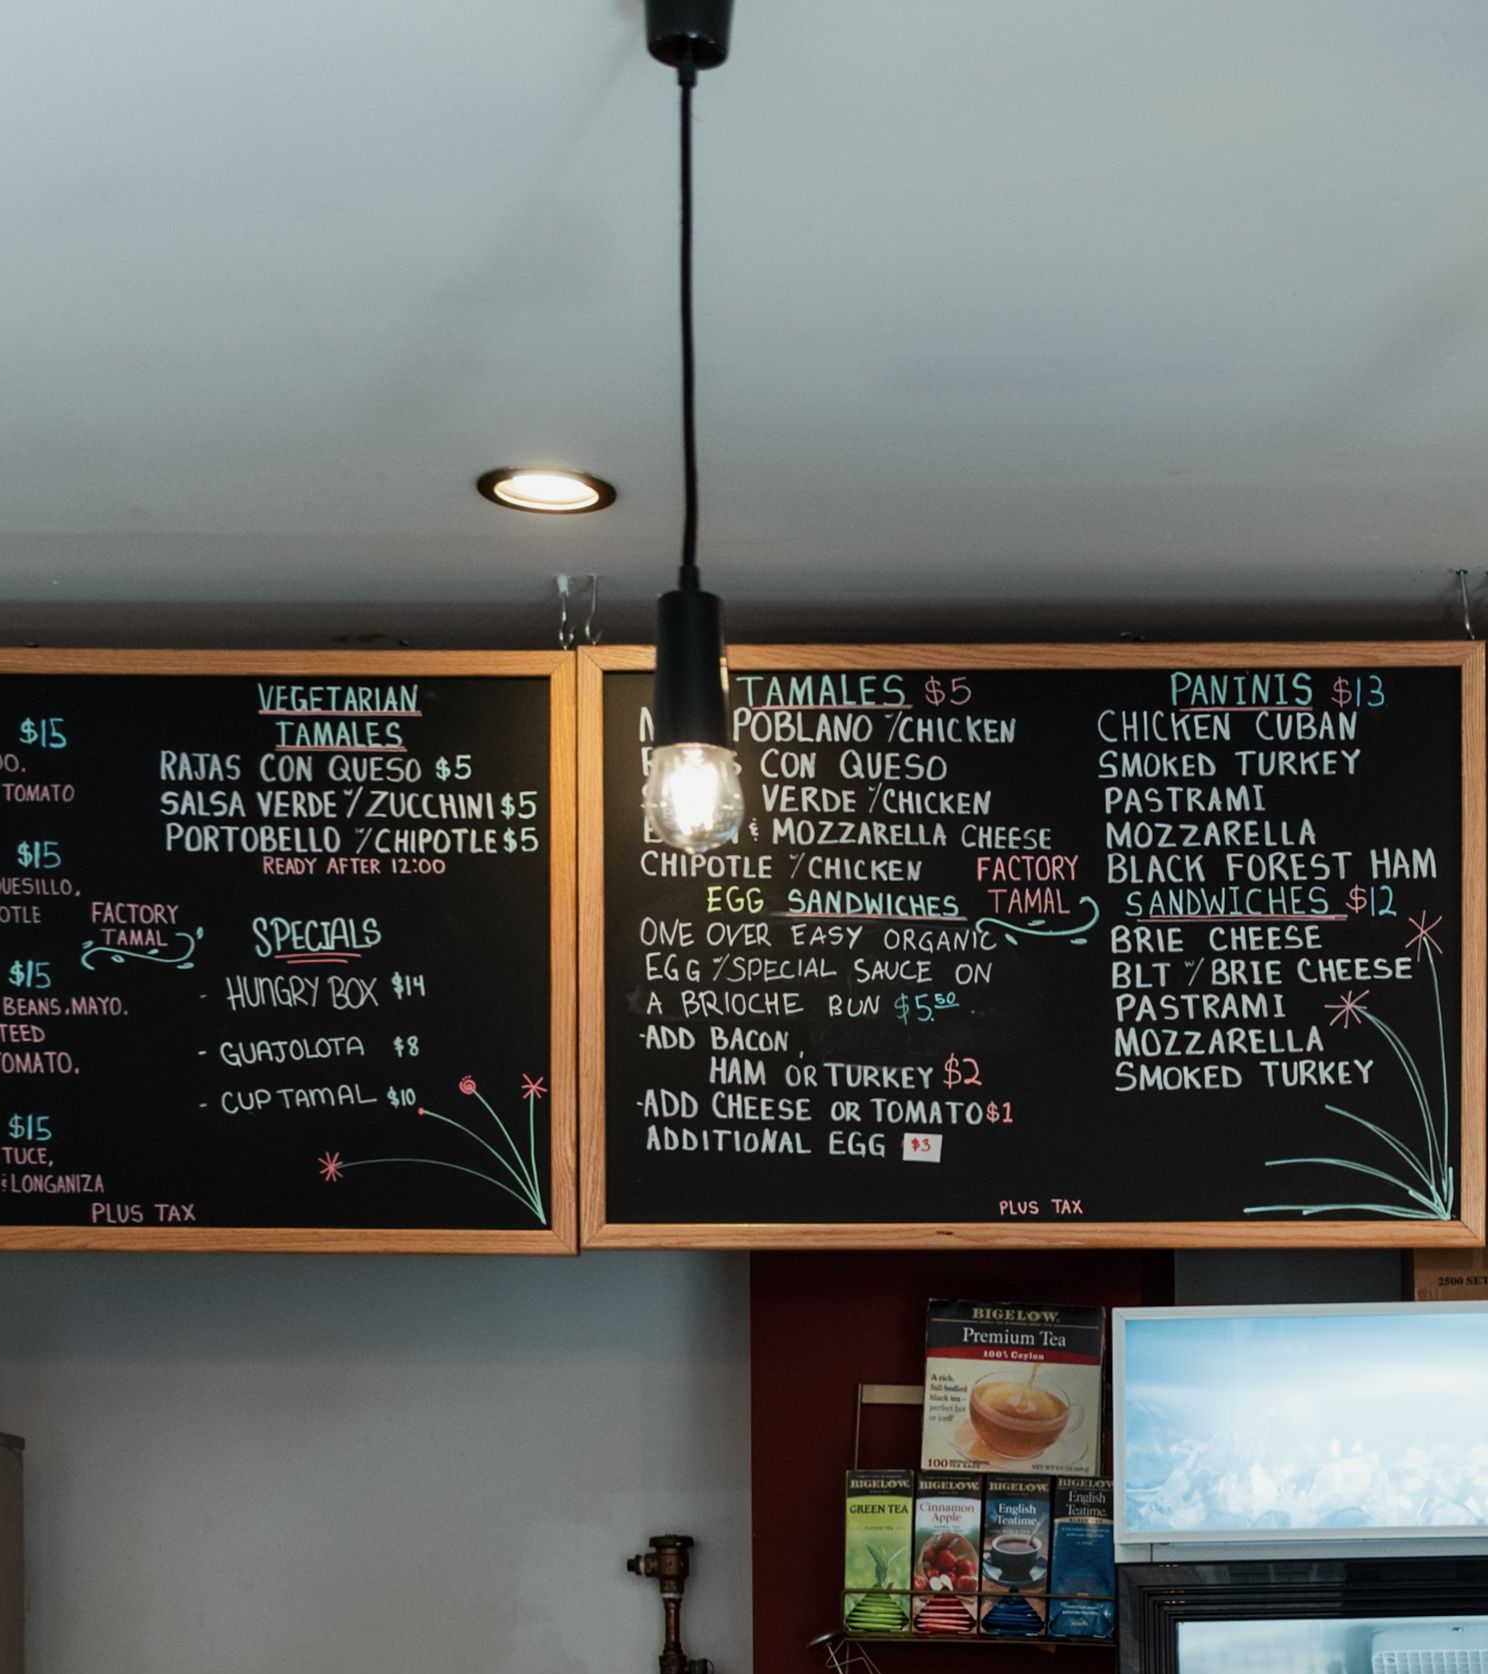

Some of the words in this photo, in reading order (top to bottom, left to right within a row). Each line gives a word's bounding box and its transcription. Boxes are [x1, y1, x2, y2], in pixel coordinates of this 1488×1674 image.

[259, 685, 420, 714] VEGETARIAN
[736, 675, 910, 709] TAMALES
[925, 676, 971, 705] $5
[1171, 672, 1312, 709] PANINIS
[1333, 675, 1384, 706] $13
[21, 718, 66, 748] $15
[277, 722, 402, 748] TAMALES
[1098, 707, 1235, 742] CHICKEN
[1253, 707, 1356, 740] CUBAN
[161, 751, 240, 780] RAJAS
[260, 754, 312, 782] CON
[329, 755, 421, 782] QUESO
[436, 755, 471, 780] $5
[1105, 785, 1265, 813] PASTRAMI
[1107, 819, 1315, 848] MOZZARELLA
[18, 842, 60, 868] $15
[1108, 853, 1205, 883] BLACK
[1227, 852, 1352, 881] FOREST
[1371, 848, 1436, 878] HAM
[1126, 887, 1332, 918] SANDWICHES
[1345, 885, 1396, 918] $12
[253, 918, 381, 958] SPECIALS
[227, 976, 318, 1010] HUNGRY
[328, 976, 378, 1009] BOX
[647, 1125, 811, 1153] ADDITIONAL
[830, 1131, 885, 1157] EGG
[92, 1203, 143, 1223] PLUS
[155, 1204, 195, 1221] TAX
[1439, 1277, 1463, 1285] 2500
[962, 1327, 1035, 1346] Premium
[1040, 1332, 1066, 1347] Tea
[850, 1505, 888, 1514] GREEN
[890, 1504, 908, 1514] TEA
[920, 1503, 975, 1513] Cinnamon
[932, 1512, 962, 1523] Apple
[998, 1504, 1036, 1516] English
